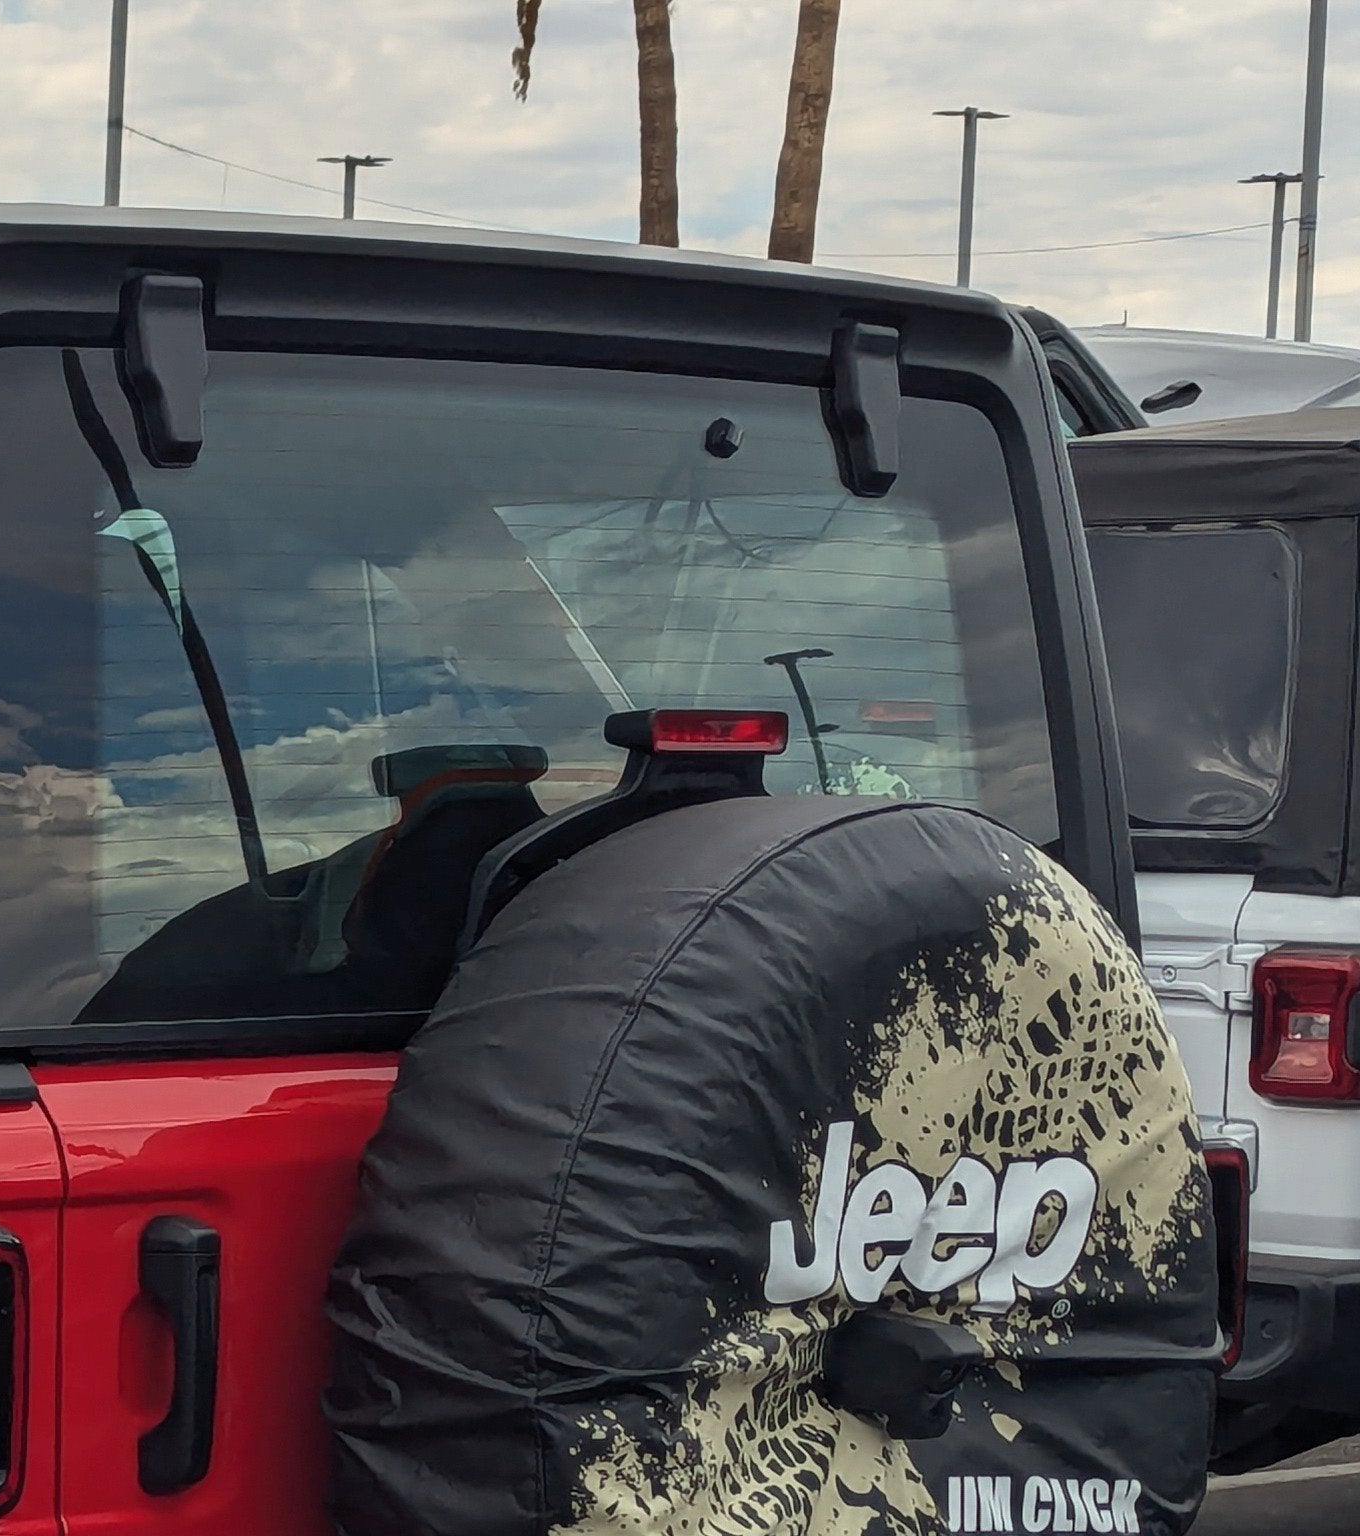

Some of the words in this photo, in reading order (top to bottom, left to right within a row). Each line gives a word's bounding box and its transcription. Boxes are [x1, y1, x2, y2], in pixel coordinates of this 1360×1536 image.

[764, 1120, 1098, 1315] Jeep
[948, 1475, 1014, 1533] JIM
[1022, 1475, 1142, 1534] CLICK
